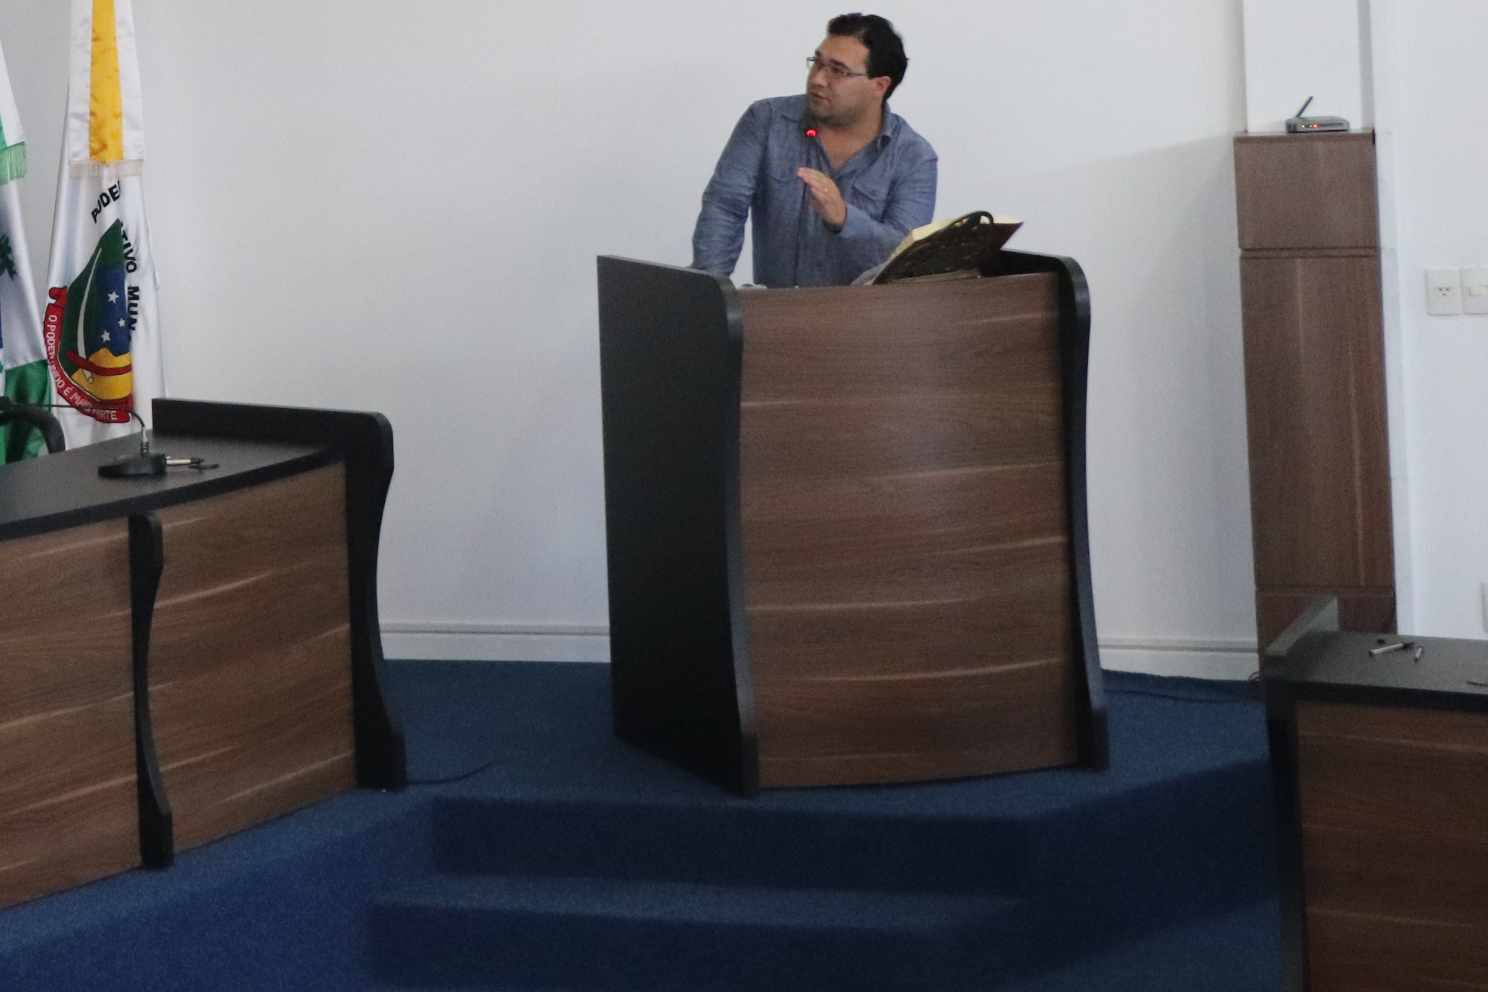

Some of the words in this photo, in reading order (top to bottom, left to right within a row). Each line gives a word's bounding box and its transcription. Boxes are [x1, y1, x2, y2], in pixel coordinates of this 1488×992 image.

[91, 180, 121, 224] PODE
[128, 286, 140, 341] MUN
[48, 314, 58, 323] O
